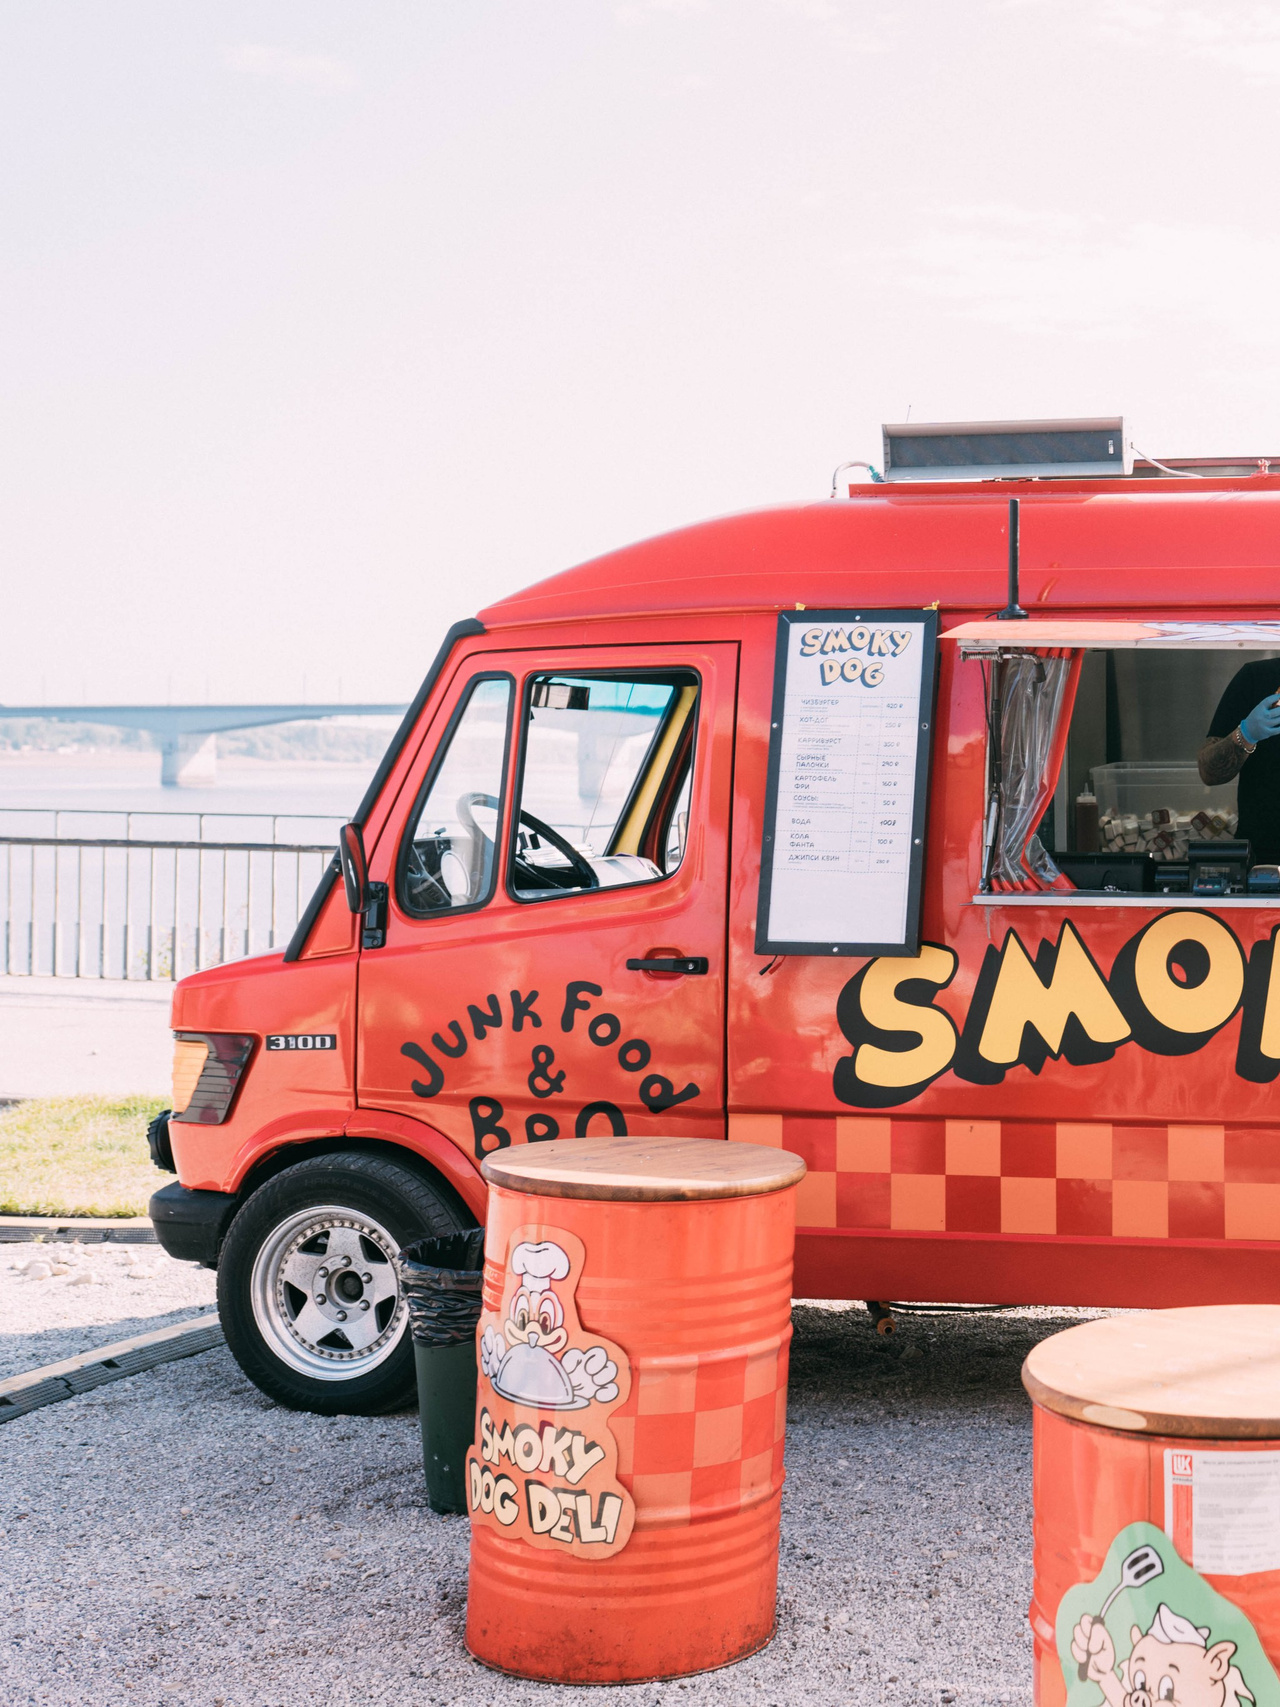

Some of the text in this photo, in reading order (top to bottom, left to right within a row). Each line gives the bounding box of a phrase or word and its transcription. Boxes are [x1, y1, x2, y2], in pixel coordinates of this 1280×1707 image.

[800, 625, 912, 658] SMOKY
[820, 657, 884, 688] DOG
[269, 1035, 331, 1049] 310D
[528, 1044, 566, 1098] &
[480, 1407, 605, 1485] SMOKY
[469, 1457, 623, 1544] DOG DELI
